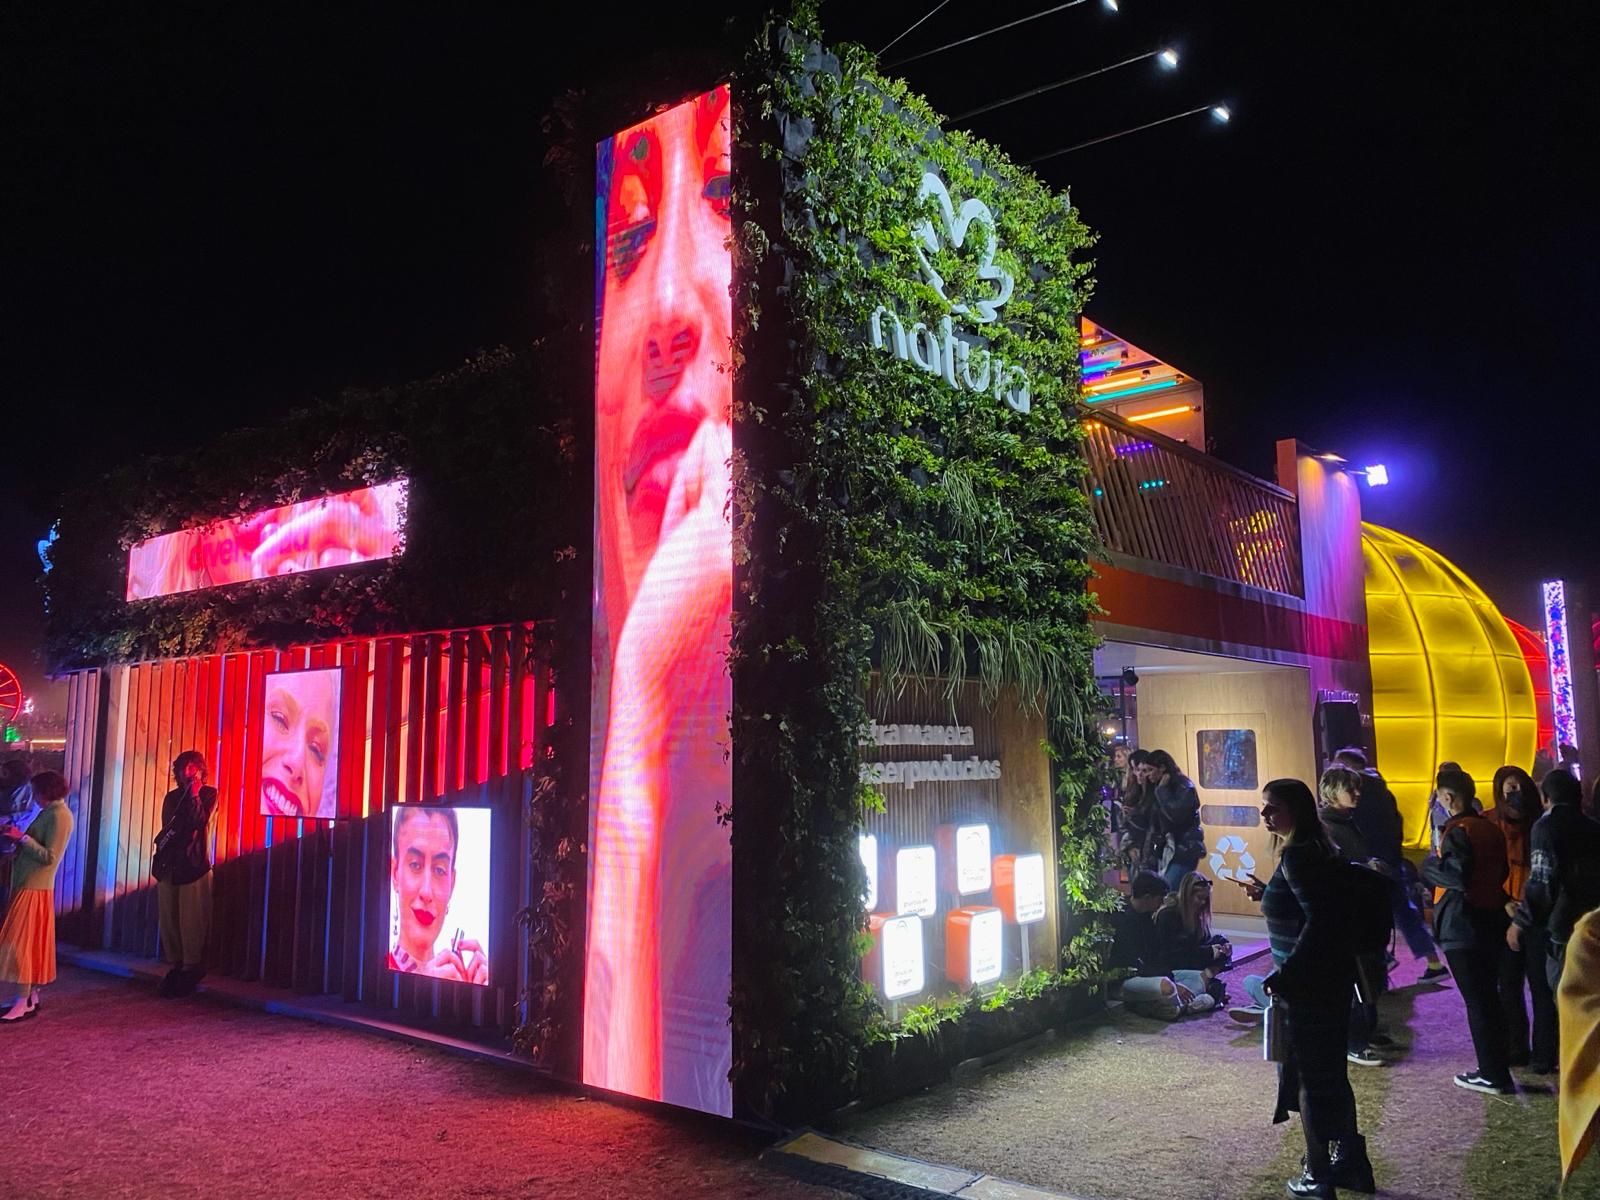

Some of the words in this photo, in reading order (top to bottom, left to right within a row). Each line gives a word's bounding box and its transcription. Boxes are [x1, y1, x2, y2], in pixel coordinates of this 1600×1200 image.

[868, 305, 1031, 414] natura
[899, 724, 975, 746] manera
[904, 753, 1001, 790] productos
